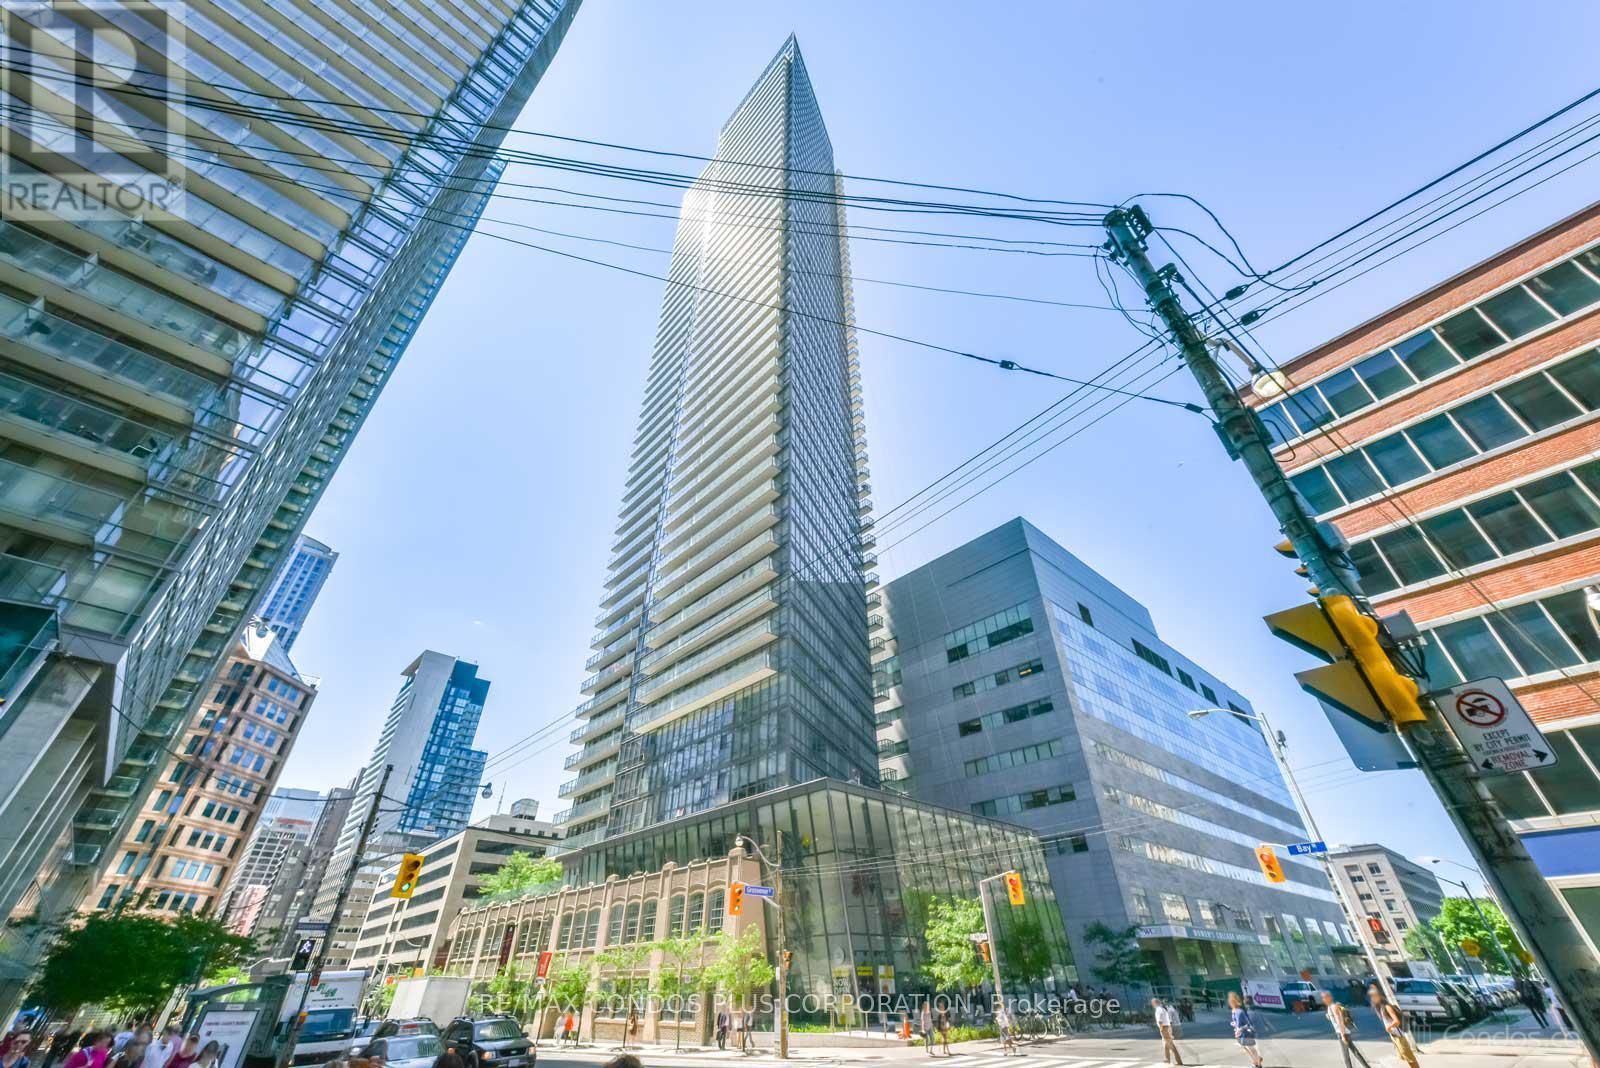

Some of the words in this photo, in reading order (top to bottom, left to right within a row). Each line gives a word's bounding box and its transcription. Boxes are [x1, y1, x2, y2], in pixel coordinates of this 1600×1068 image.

[1482, 729, 1510, 740] EXCEPT
[1473, 743, 1484, 752] BY
[1485, 740, 1502, 749] CITY
[1504, 733, 1531, 745] PERMIT
[1490, 750, 1532, 764] REMOVAL
[1504, 761, 1528, 770] ZONE
[1296, 843, 1312, 855] Bay
